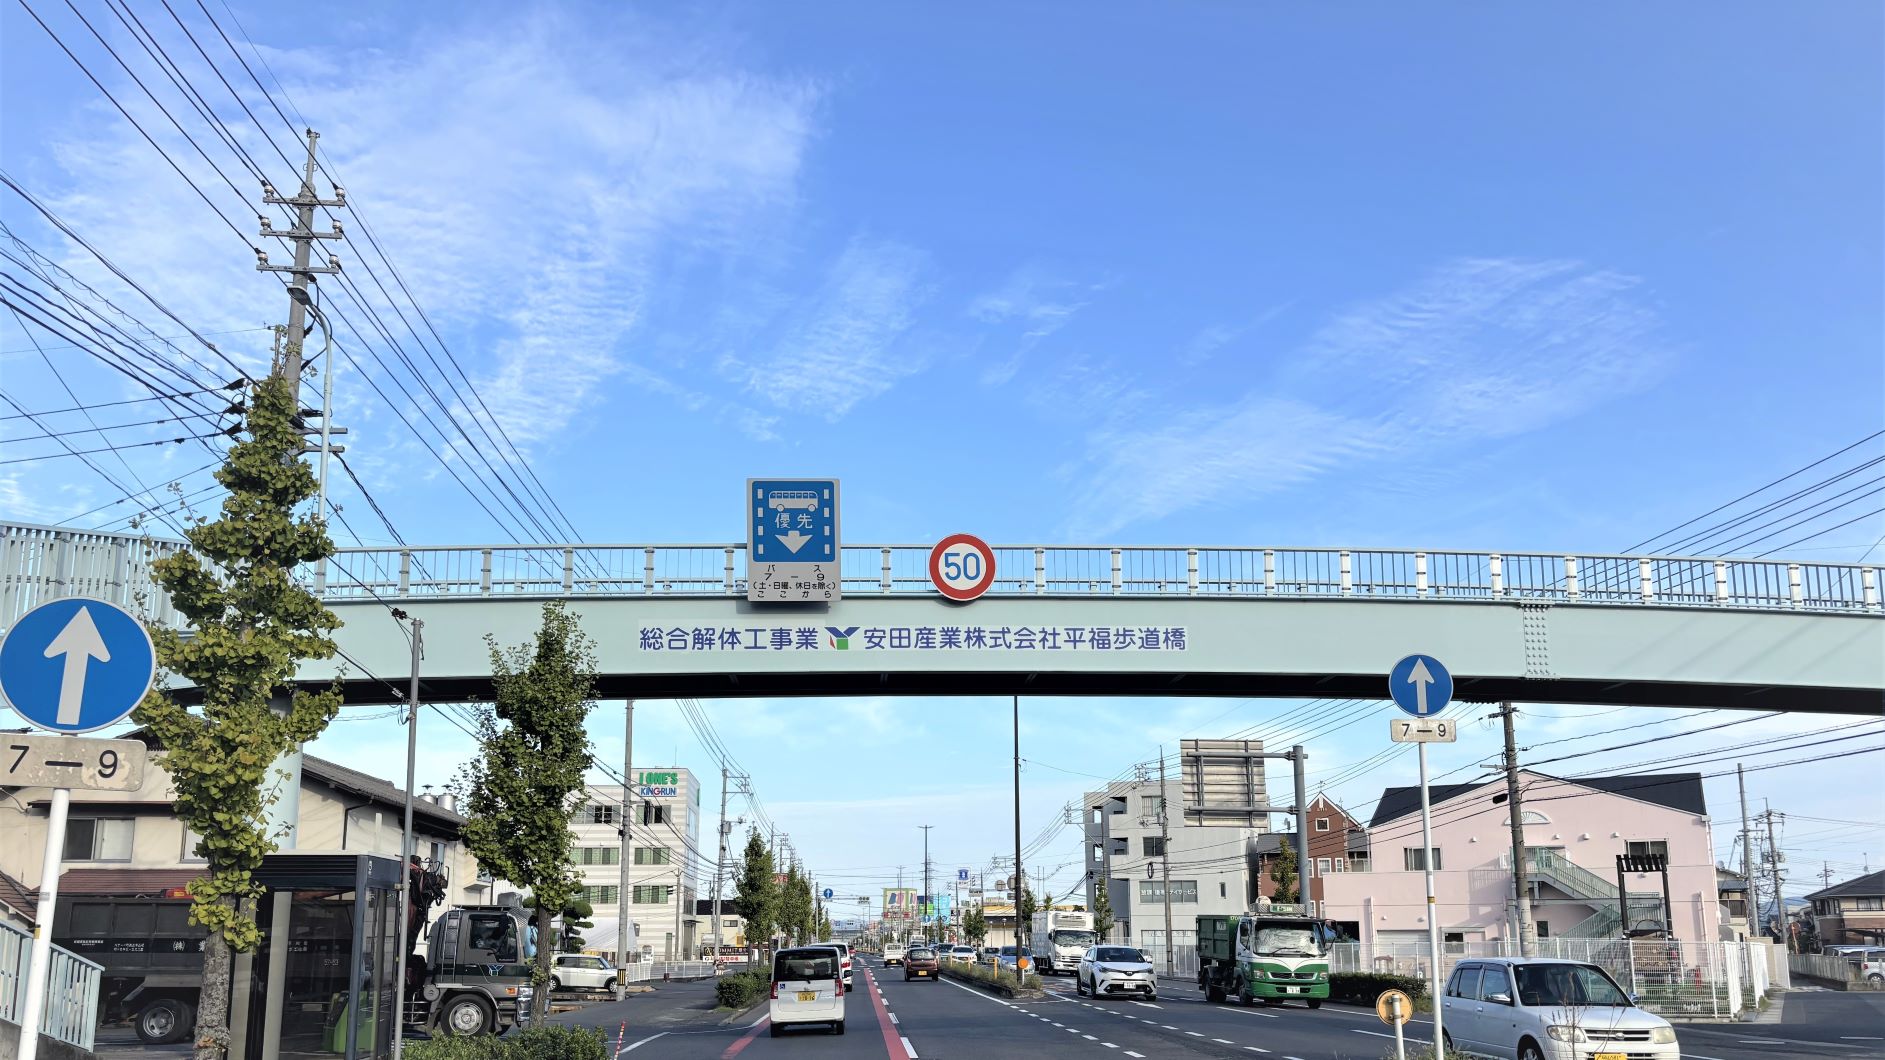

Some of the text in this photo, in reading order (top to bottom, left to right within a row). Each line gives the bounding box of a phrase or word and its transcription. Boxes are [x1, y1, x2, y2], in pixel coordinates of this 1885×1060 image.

[775, 513, 813, 528] 優先
[944, 552, 981, 581] 50
[757, 590, 832, 598] ここから
[639, 626, 1187, 651] 総合解体工事業 安田産業株式会社平福歩道橋
[640, 786, 676, 796] KINGRUN
